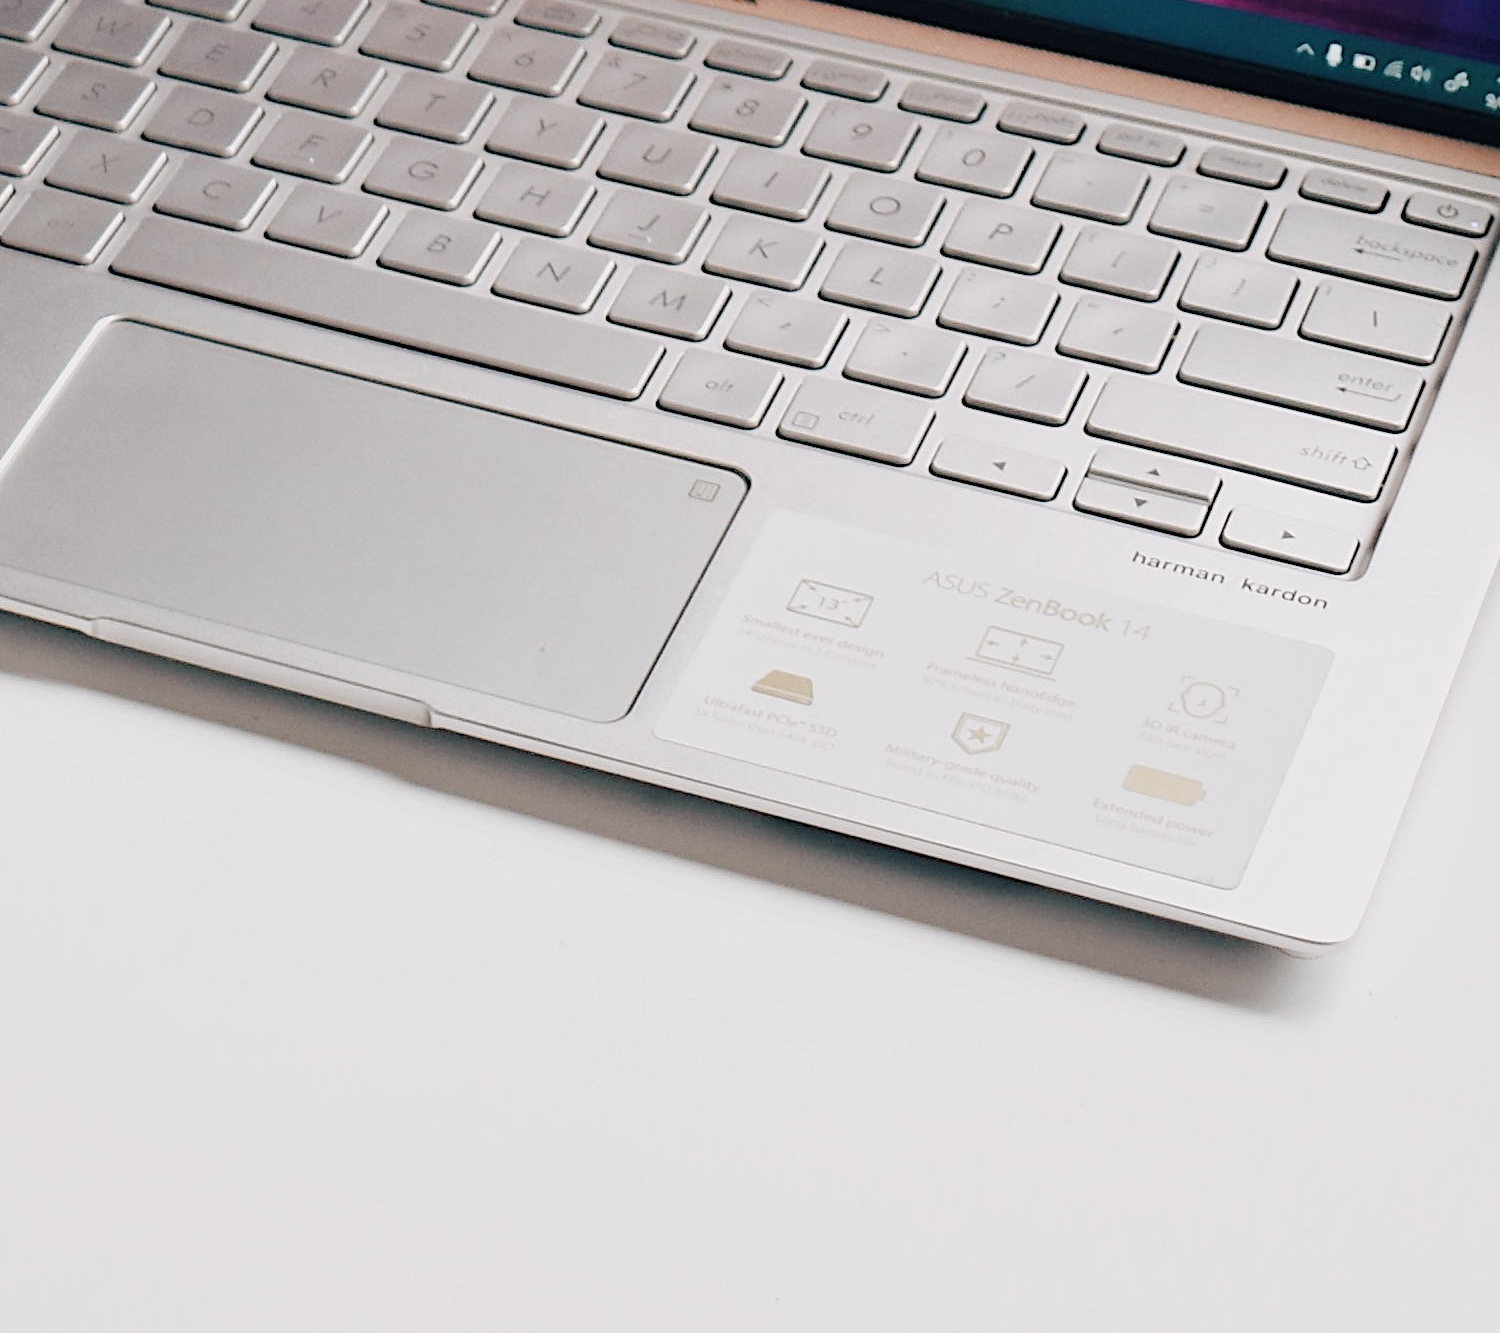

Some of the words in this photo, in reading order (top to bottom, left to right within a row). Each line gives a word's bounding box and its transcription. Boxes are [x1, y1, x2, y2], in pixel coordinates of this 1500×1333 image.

[1354, 233, 1460, 270] backspace
[1336, 369, 1396, 396] enter
[1298, 442, 1349, 467] shift
[1130, 550, 1226, 586] harman
[1241, 575, 1329, 611] kardon
[921, 569, 991, 600] ASUS
[993, 585, 1112, 633] ZenBook
[1120, 618, 1152, 641] 14
[742, 612, 801, 637] Smallest
[836, 637, 885, 659] design
[703, 693, 764, 719] Ultrafast
